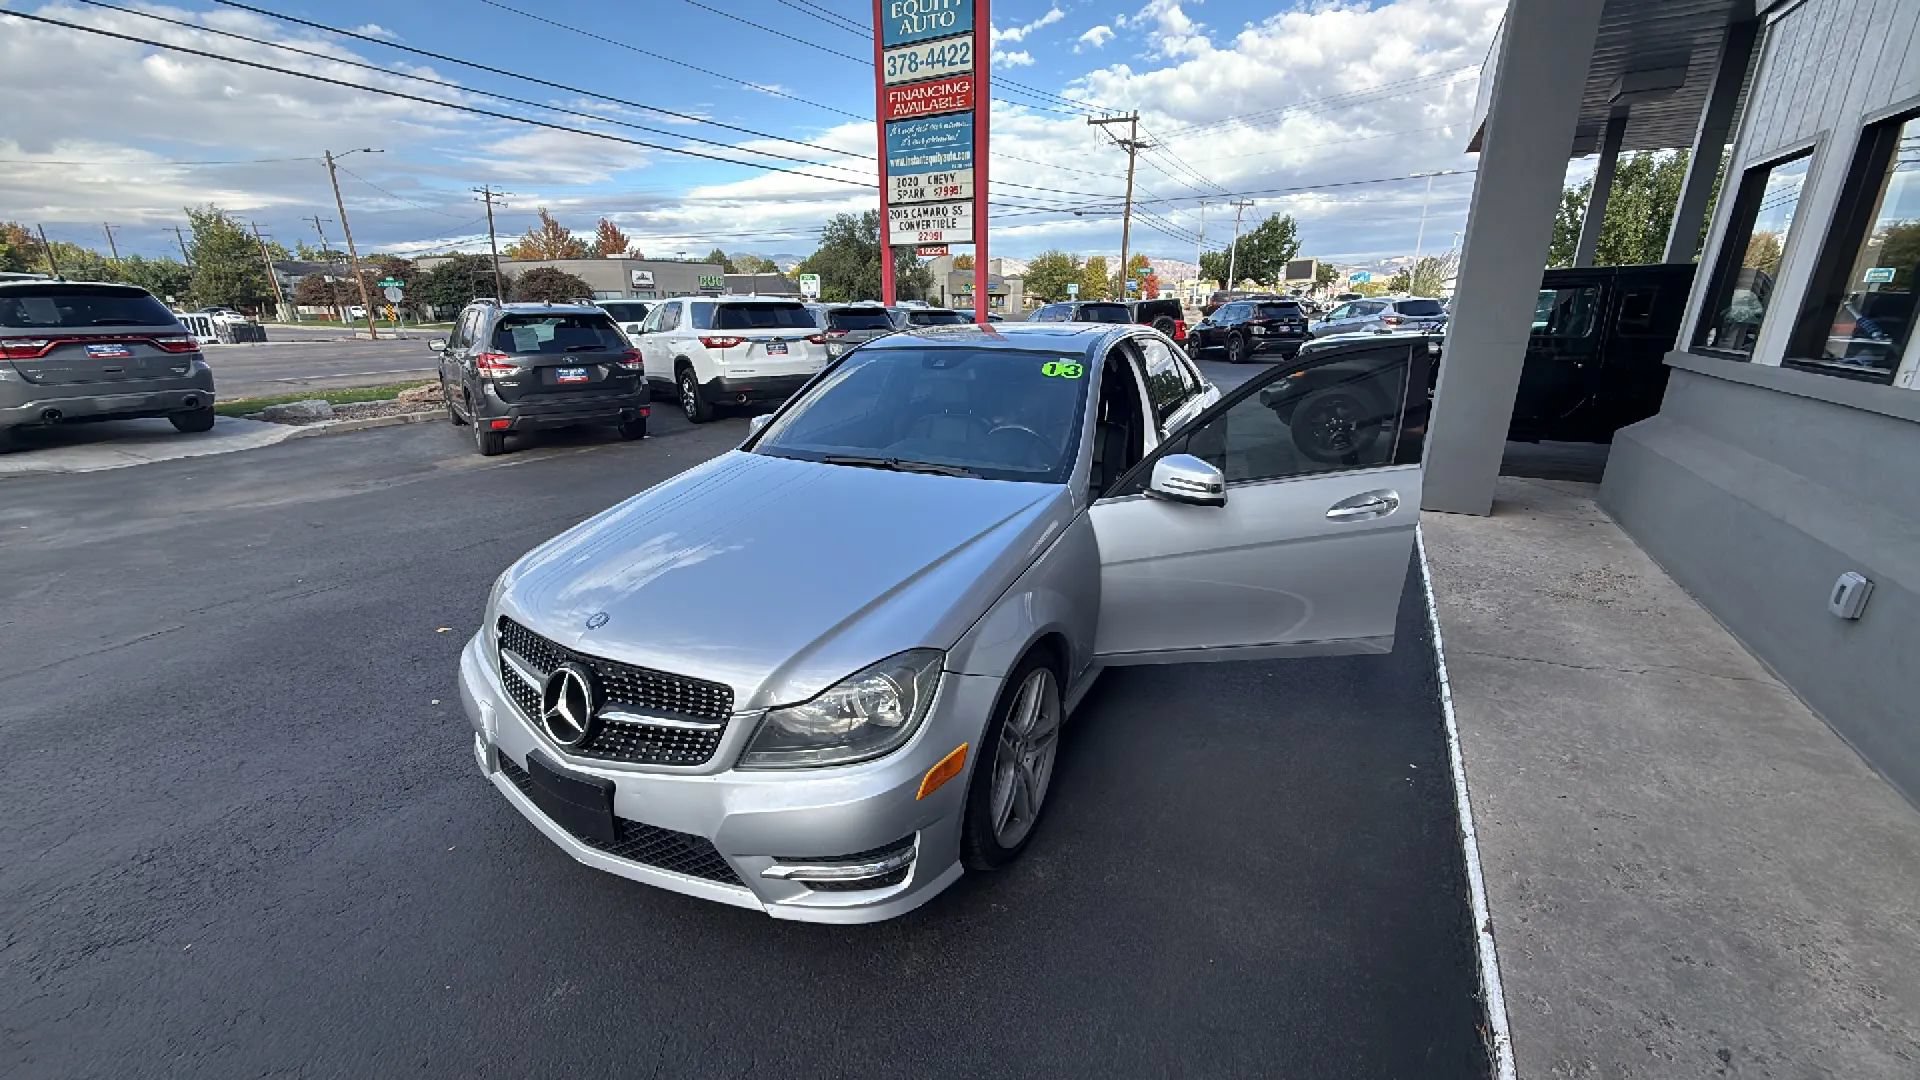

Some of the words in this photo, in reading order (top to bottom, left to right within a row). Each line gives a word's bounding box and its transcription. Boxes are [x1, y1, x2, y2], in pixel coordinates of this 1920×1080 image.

[899, 10, 955, 35] AUTO
[887, 42, 970, 77] 378-4422
[889, 81, 970, 103] FINANCING
[893, 95, 966, 115] AVAILABLE
[897, 175, 918, 189] 2020
[928, 172, 957, 185] CHEVY
[897, 187, 925, 200] SPARK
[890, 209, 909, 221] 2015
[911, 205, 948, 219] CAMARO
[952, 205, 963, 216] SS
[899, 218, 957, 231] CONVERTIBLE
[1049, 363, 1081, 377] 13
